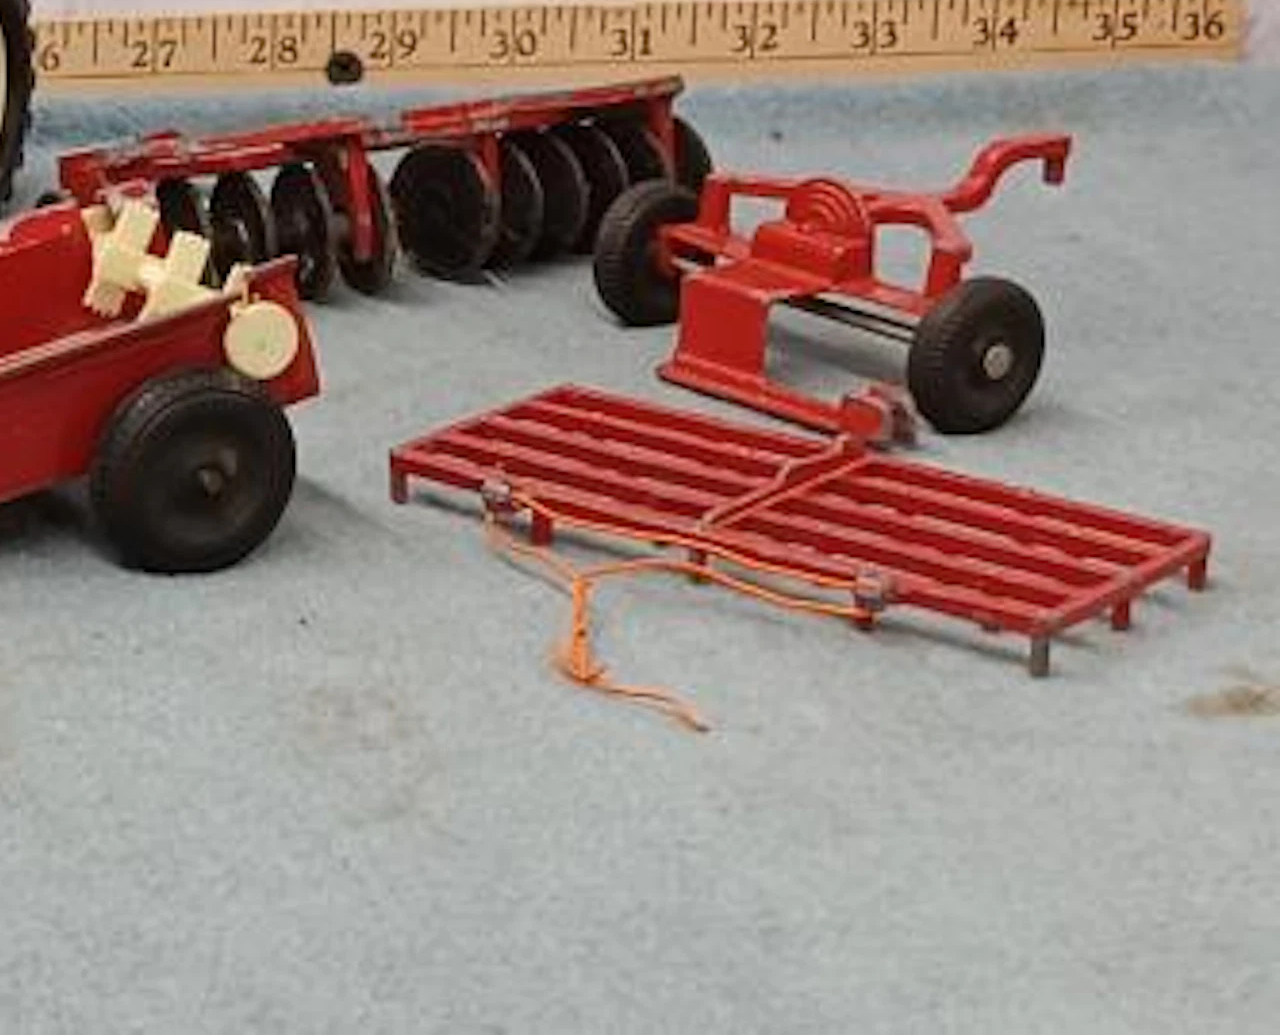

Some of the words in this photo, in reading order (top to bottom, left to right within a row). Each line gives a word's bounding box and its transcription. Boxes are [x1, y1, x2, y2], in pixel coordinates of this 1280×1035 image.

[39, 41, 61, 71] 6
[130, 39, 180, 68] 27
[248, 35, 300, 65] 28
[368, 29, 418, 60] 29
[489, 29, 537, 59] 30
[610, 27, 652, 57] 31
[730, 21, 780, 52] 32
[850, 19, 900, 50] 33
[971, 16, 1020, 47] 34
[1091, 11, 1139, 42] 35
[1182, 9, 1226, 40] 36
